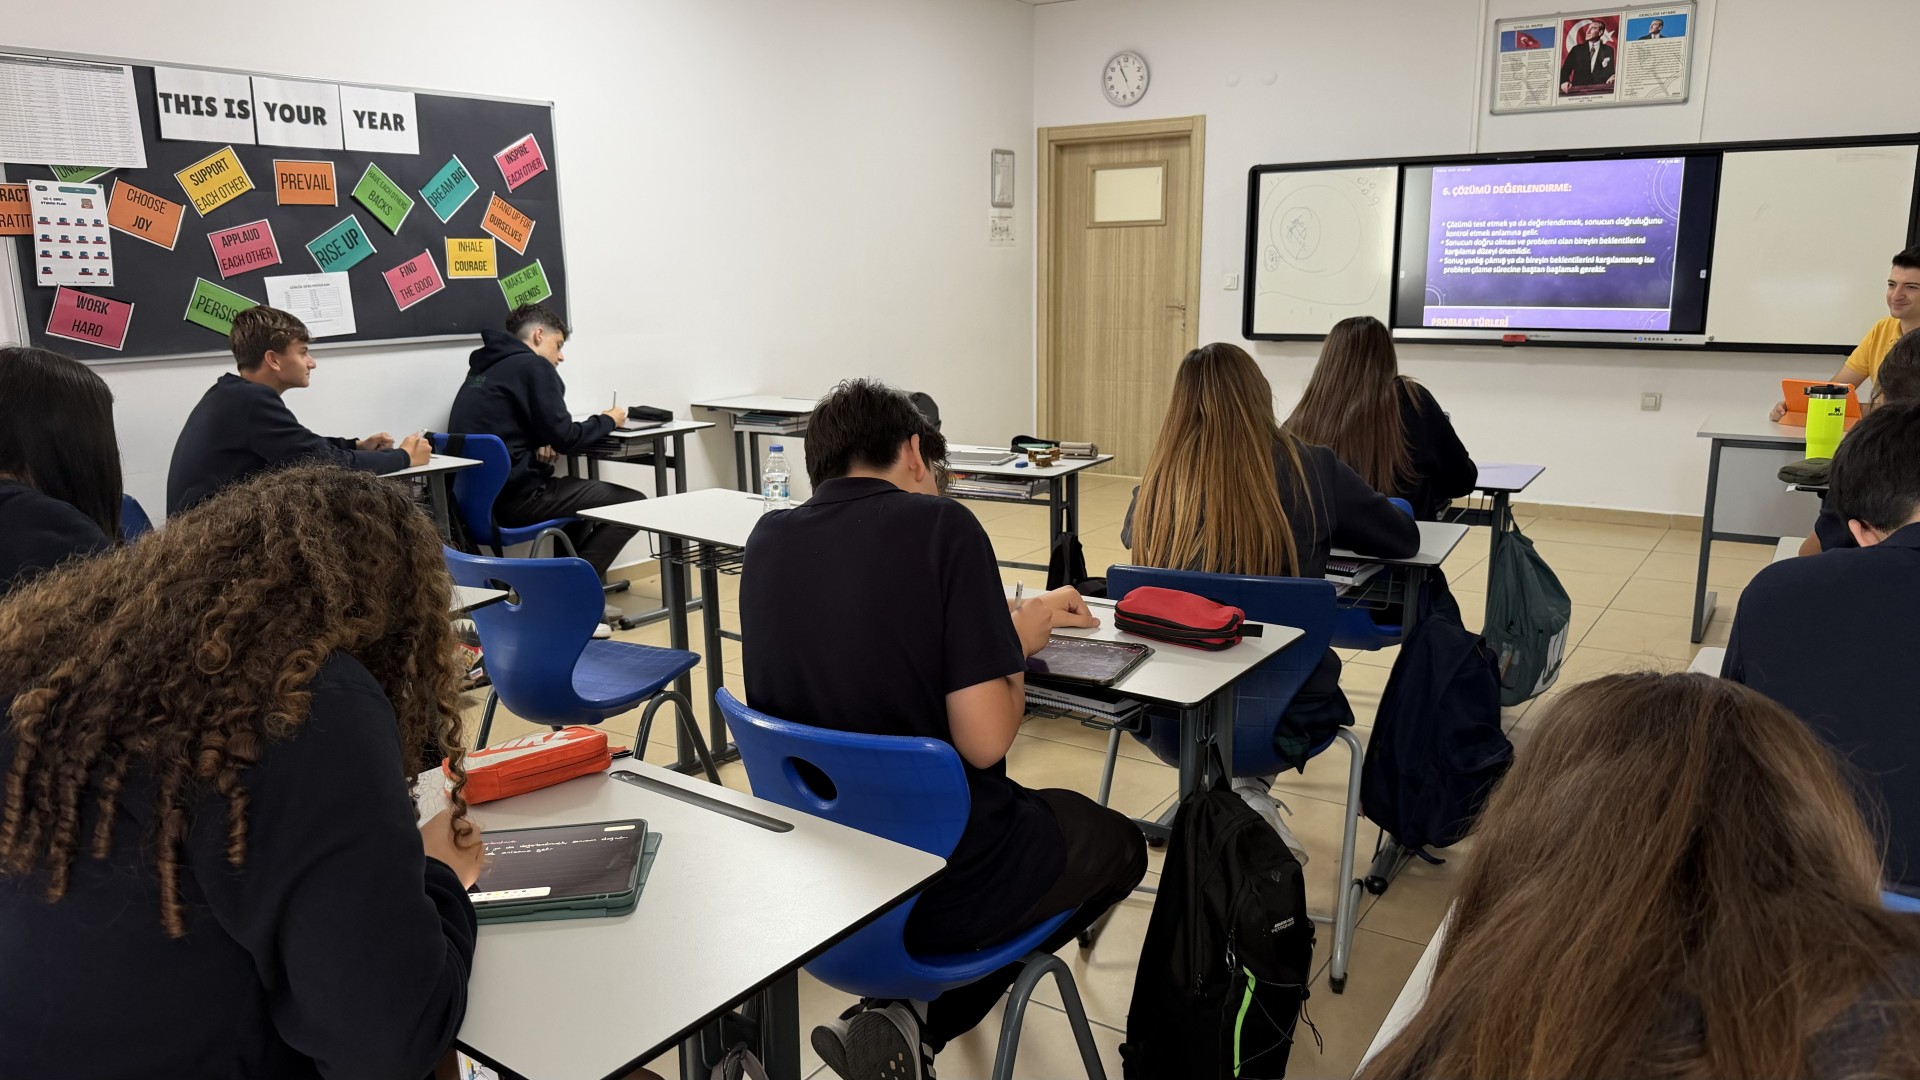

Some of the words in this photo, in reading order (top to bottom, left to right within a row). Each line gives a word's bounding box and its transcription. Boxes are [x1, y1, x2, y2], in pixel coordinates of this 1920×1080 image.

[159, 92, 217, 117] THIS
[223, 97, 250, 120] IS
[263, 101, 327, 126] YOUR
[353, 109, 406, 132] YEAR
[504, 144, 529, 164] INSPIRE
[189, 157, 230, 187] SUPPORT
[507, 169, 524, 186] EACH
[522, 157, 542, 176] OTHER
[280, 172, 331, 192] PREVAIL
[368, 170, 381, 185] HAVE
[380, 181, 392, 195] EACH
[427, 178, 455, 208] DREAM
[452, 167, 467, 183] BIG
[1442, 187, 1451, 196] 6.
[1452, 185, 1491, 197] ÇÖZÜMÜ
[0, 187, 29, 202] RACT
[126, 188, 168, 215] CHOOSE
[195, 191, 219, 212] EACH
[218, 176, 247, 202] OTHER
[368, 190, 393, 216] BACKS
[0, 212, 31, 228] RATIT
[132, 215, 153, 232] JOY
[492, 197, 513, 217] STAND
[512, 208, 520, 220] UP
[519, 213, 532, 230] FOR
[1446, 221, 1472, 229] Çözümü
[1518, 219, 1526, 227] da
[1585, 218, 1614, 226] sonucun
[221, 228, 261, 248] APPLAUD
[489, 214, 523, 243] OURSELVES
[1446, 229, 1469, 237] kontrol
[1470, 229, 1491, 237] etmek
[314, 239, 346, 268] RISE
[343, 228, 359, 250] UP
[458, 240, 484, 253] INHALE
[1445, 238, 1473, 247] Sonucun
[1474, 238, 1494, 247] doğru
[1526, 238, 1557, 246] problemi
[1558, 237, 1573, 245] olan
[221, 256, 245, 271] EACH
[246, 247, 274, 264] OTHER
[454, 260, 488, 272] COURAGE
[1515, 256, 1525, 264] da
[1644, 256, 1655, 264] ise
[399, 261, 417, 278] FIND
[504, 272, 522, 290] MAKE
[523, 265, 538, 283] NEW
[1443, 266, 1470, 275] problem
[400, 286, 415, 301] THE
[415, 276, 434, 294] GOOD
[514, 286, 541, 305] FRIENDS
[76, 294, 110, 316] WORK
[195, 295, 240, 324] PERSIS
[71, 318, 104, 338] HARD
[1431, 317, 1472, 327] PROBLEM
